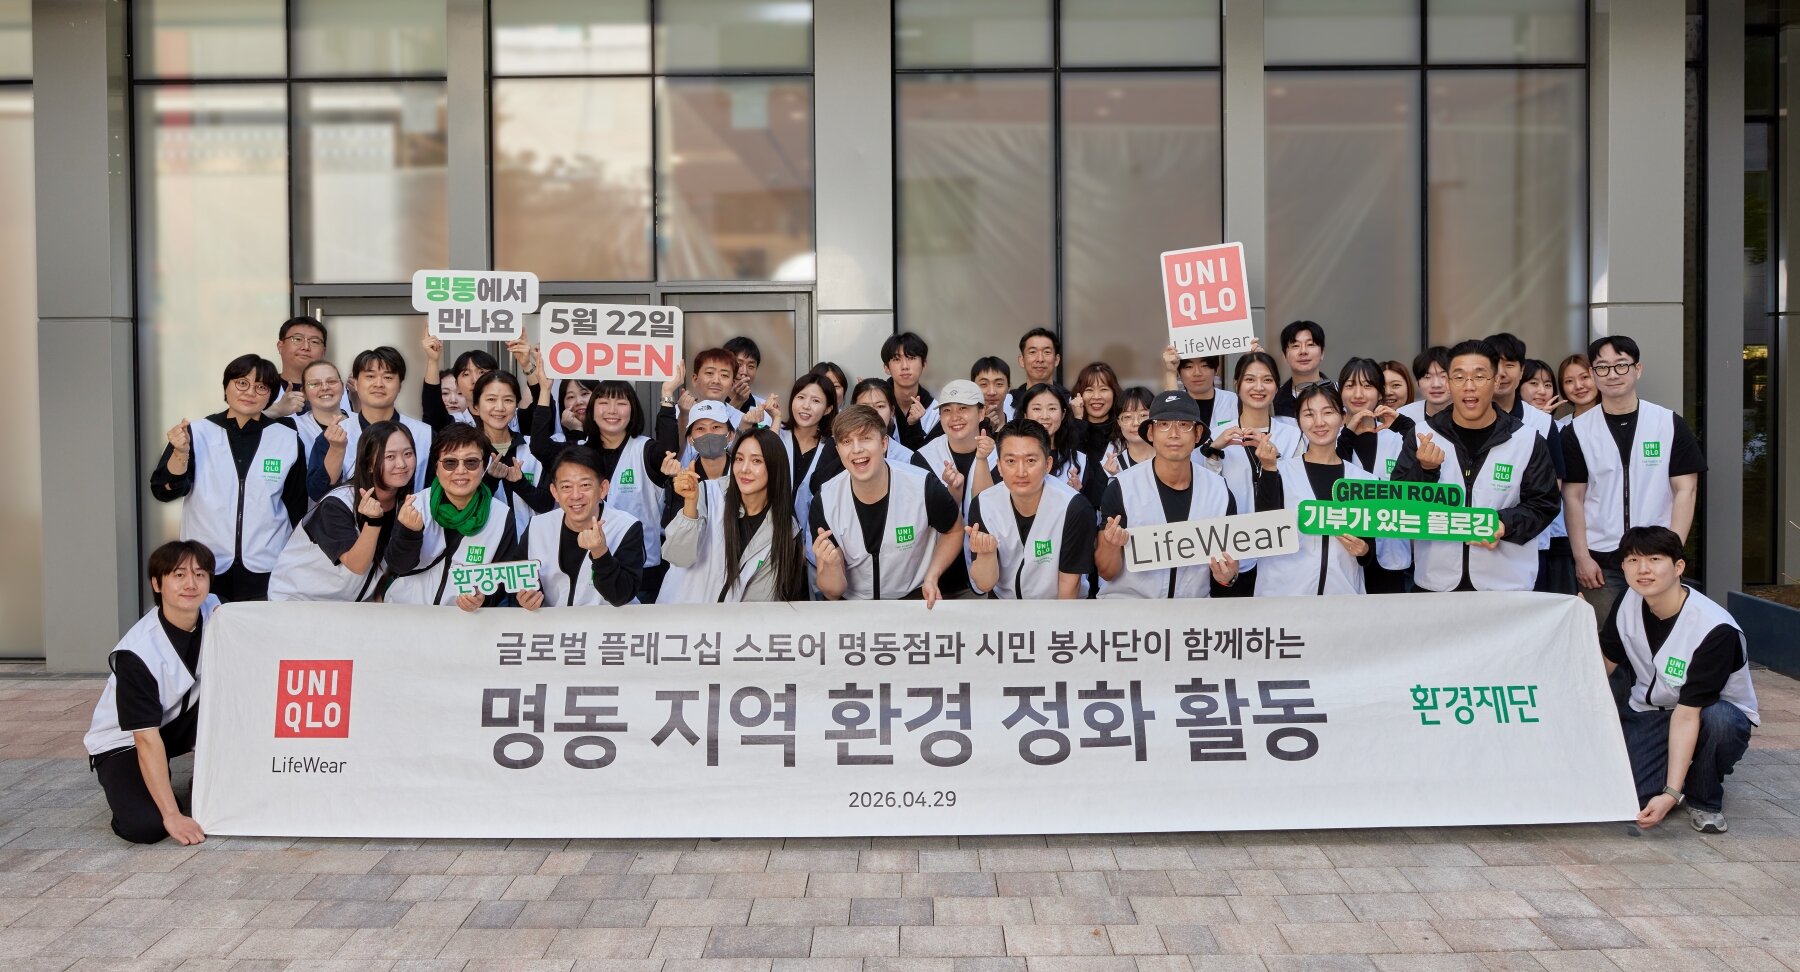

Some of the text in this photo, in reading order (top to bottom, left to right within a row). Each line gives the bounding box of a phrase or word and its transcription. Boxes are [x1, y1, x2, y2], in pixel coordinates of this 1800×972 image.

[1174, 257, 1228, 287] UNI
[425, 276, 527, 303] 명동에서
[1178, 287, 1237, 321] QLO
[438, 308, 515, 334] 만나요
[550, 308, 675, 338] 5월 22일
[1174, 335, 1250, 355] LifeWear
[549, 341, 674, 377] OPEN
[1495, 470, 1510, 480] QLO
[1496, 464, 1510, 473] UNI
[1336, 482, 1461, 507] GREEN ROAD
[1304, 506, 1494, 536] 기부가 있는 플로깅
[470, 548, 482, 556] UNI
[898, 535, 912, 543] QLO
[1036, 540, 1049, 549] UNI
[1130, 523, 1292, 565] LifeWear
[468, 554, 482, 562] QLO
[452, 564, 536, 593] 환경재단
[497, 627, 1305, 666] 글로벌 플래그십 스토어 명동점과 시민 봉사단이 함께하는
[1667, 667, 1683, 677] QLO
[1669, 659, 1684, 670] UNI
[286, 669, 339, 696] UNI
[284, 701, 342, 733] QLO
[1409, 684, 1540, 725] 환경재단
[481, 678, 1328, 770] 명동 지역 환경 정화 활동
[271, 756, 347, 773] LifeWear
[848, 791, 957, 809] 2026.04.29
